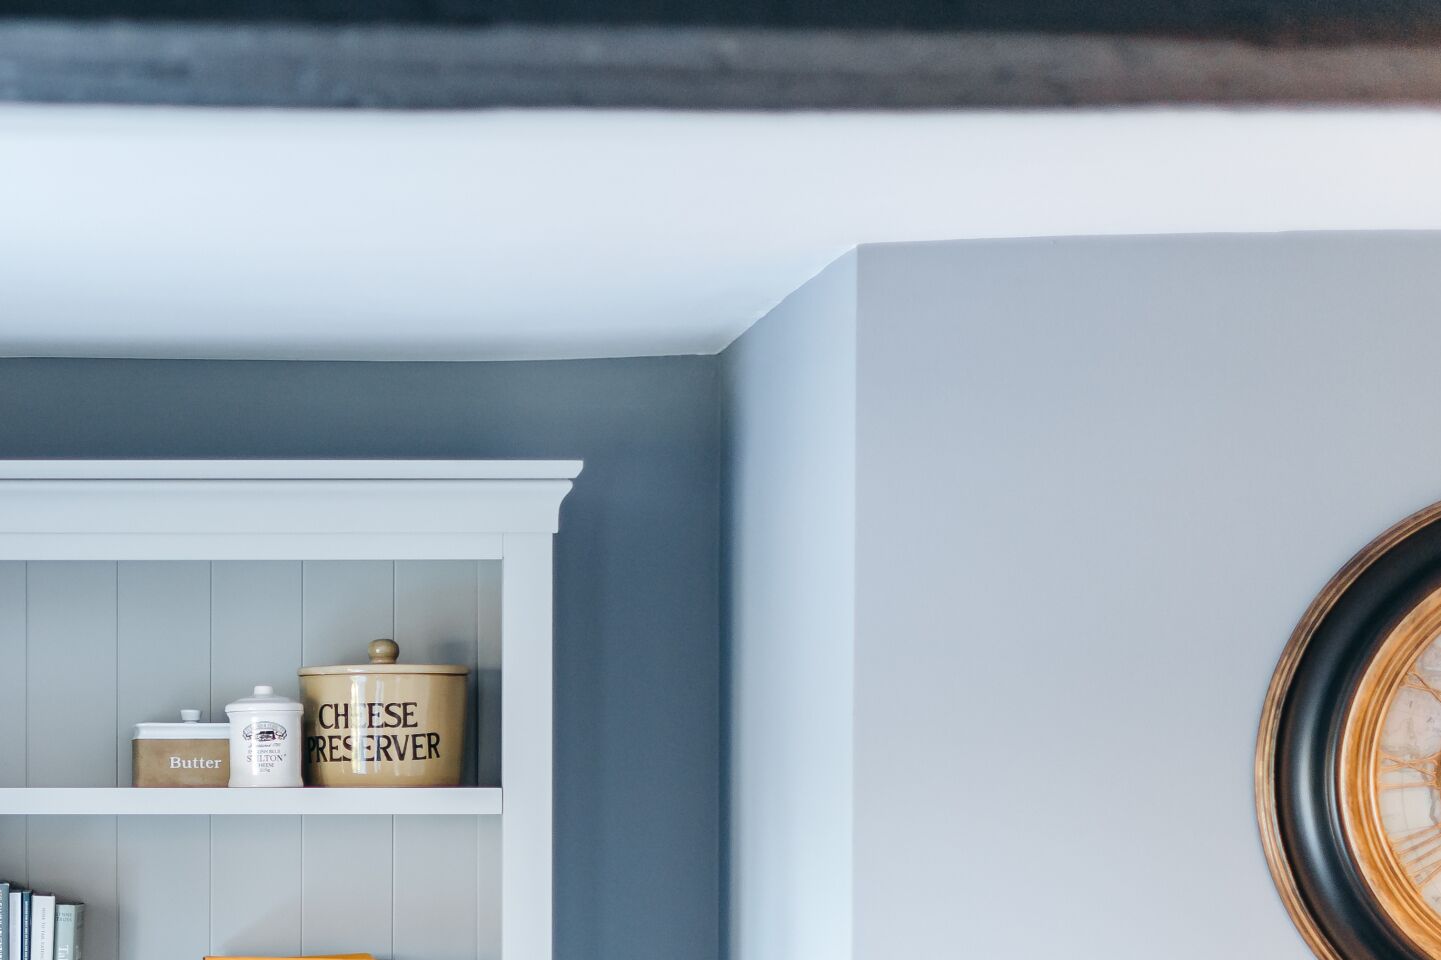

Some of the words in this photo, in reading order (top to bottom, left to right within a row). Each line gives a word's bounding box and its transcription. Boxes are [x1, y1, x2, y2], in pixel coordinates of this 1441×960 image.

[307, 732, 440, 763] PRESERVER
[170, 756, 222, 770] Butter
[246, 754, 282, 762] SILTON
